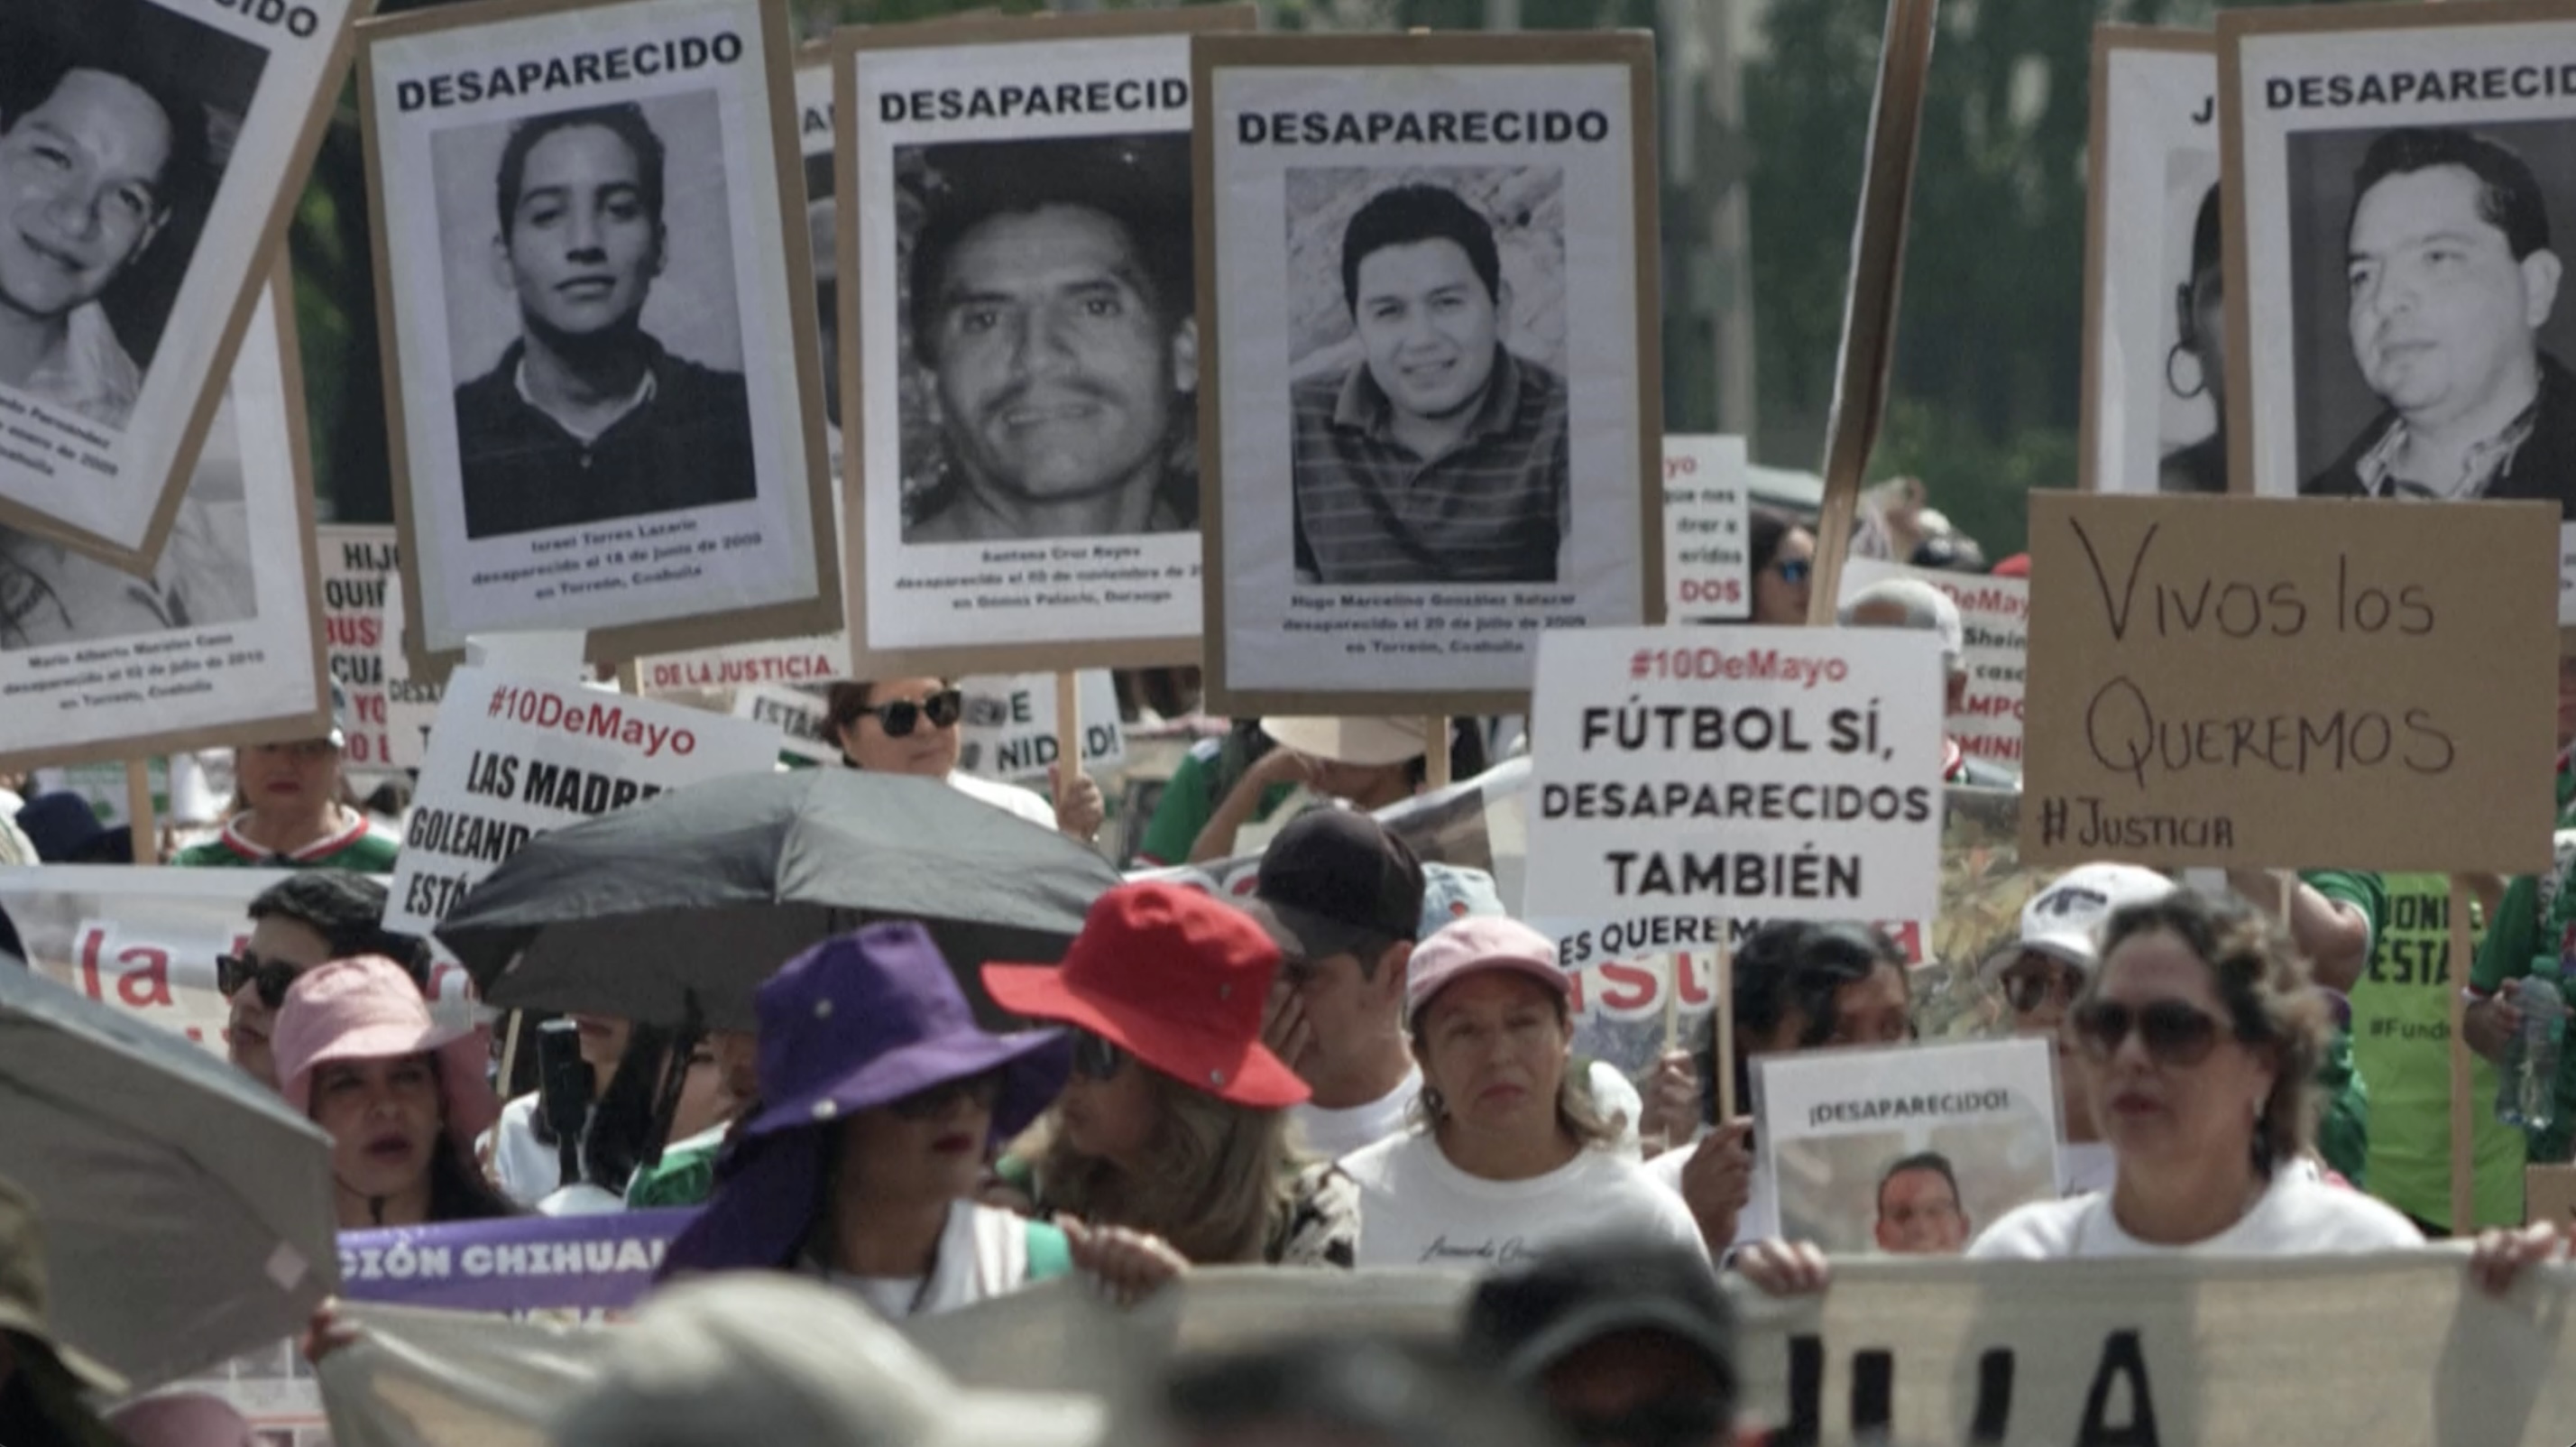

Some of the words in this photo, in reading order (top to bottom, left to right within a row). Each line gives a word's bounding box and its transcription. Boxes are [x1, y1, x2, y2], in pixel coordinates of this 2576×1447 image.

[397, 32, 742, 112] DESAPARECIDO
[1238, 109, 1609, 144] DESAPARECIDO
[472, 558, 580, 587] desaparecido
[629, 547, 649, 564] de
[697, 537, 717, 554] de
[630, 563, 703, 586] Coahuila
[895, 572, 1003, 591] desaparecido
[1283, 617, 1399, 634] desaparecido
[1449, 639, 1525, 654] Coahuila
[655, 664, 680, 687] DE
[686, 661, 713, 685] LA
[1631, 648, 1848, 689] #10DeMayo
[487, 685, 695, 757] #10DeMayo
[1581, 695, 1809, 752] FÚTBOL
[1827, 697, 1894, 761] SÍ,
[466, 750, 520, 800] LAS
[523, 760, 673, 815] MADR
[1541, 783, 1930, 823] DESAPARECIDOS
[408, 806, 548, 862] GOLEAND
[1605, 842, 1862, 899] TAMBIÉN
[1809, 1088, 2010, 1128] ¡DESAPARECIDO!
